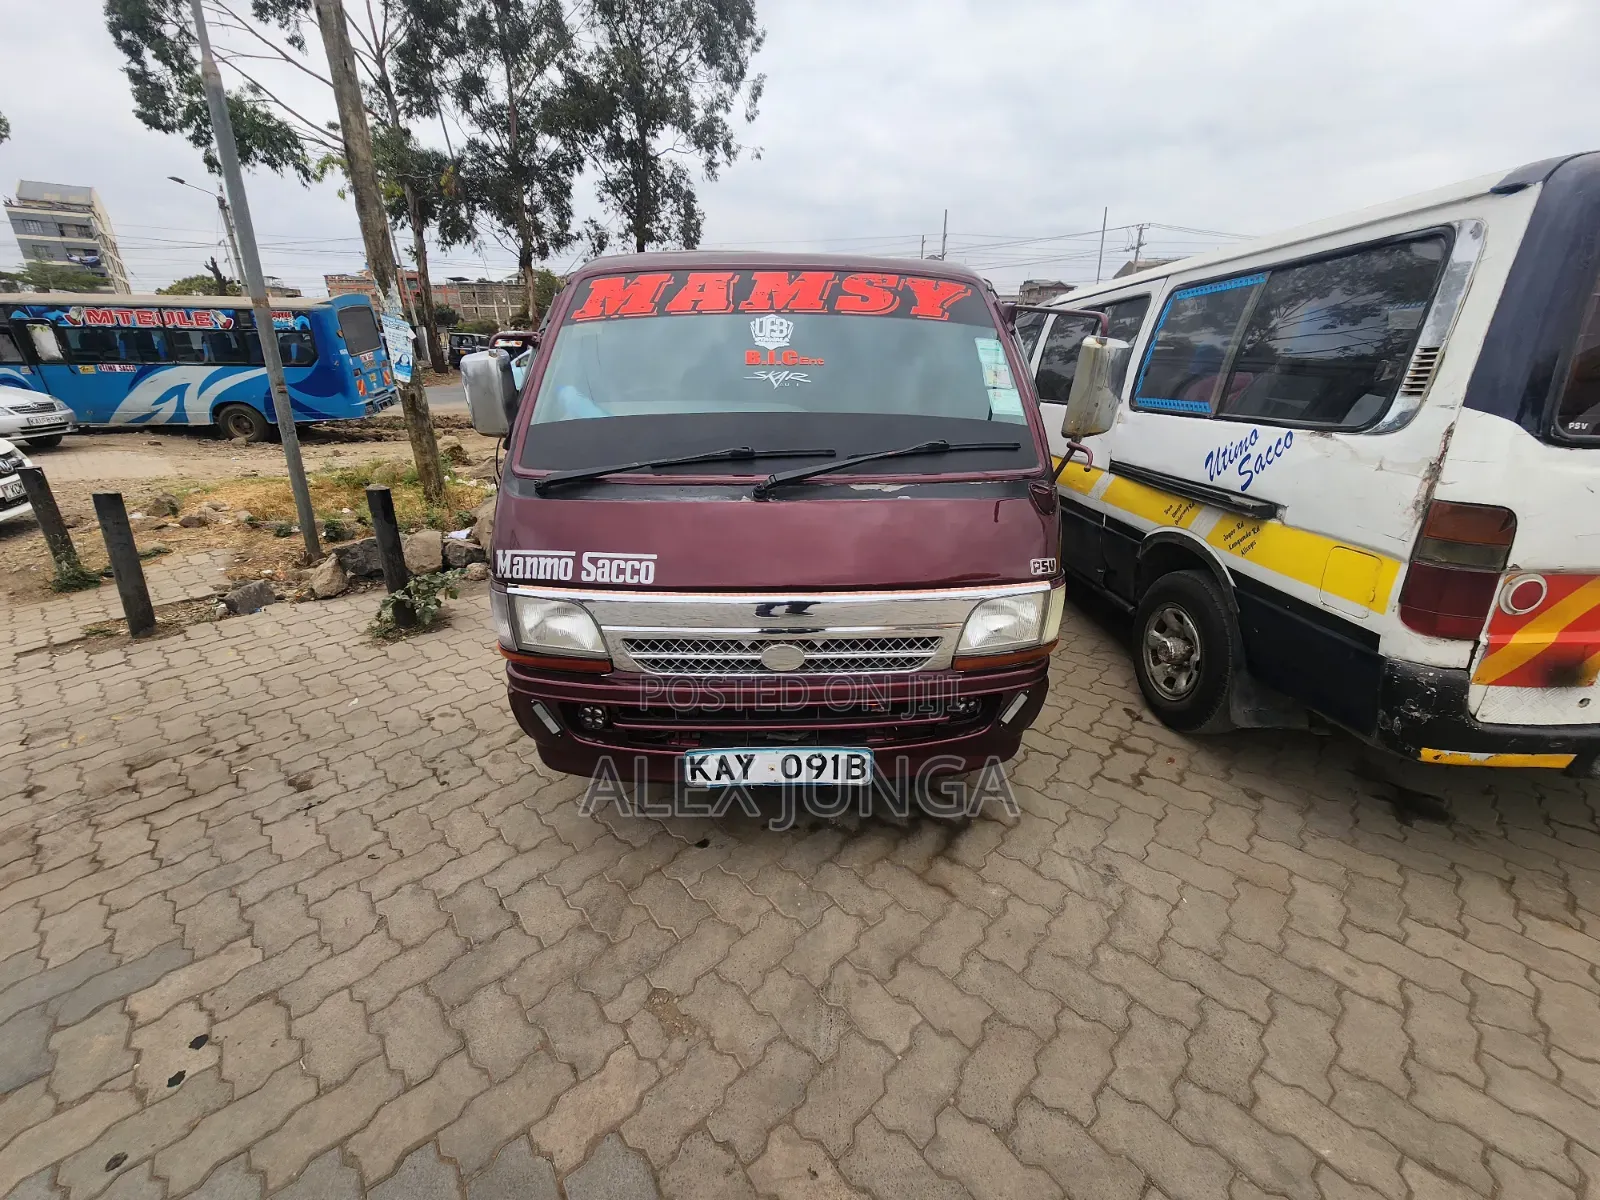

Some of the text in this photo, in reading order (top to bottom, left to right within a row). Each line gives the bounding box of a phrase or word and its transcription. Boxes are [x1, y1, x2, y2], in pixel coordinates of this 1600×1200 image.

[571, 271, 971, 321] MAMSY
[84, 308, 213, 327] MTEULE
[1568, 422, 1588, 430] PSV
[1238, 430, 1293, 491] Sacco
[496, 550, 658, 584] Manmo Sacco
[1032, 559, 1056, 574] PSV
[689, 753, 866, 781] KAY 091B
